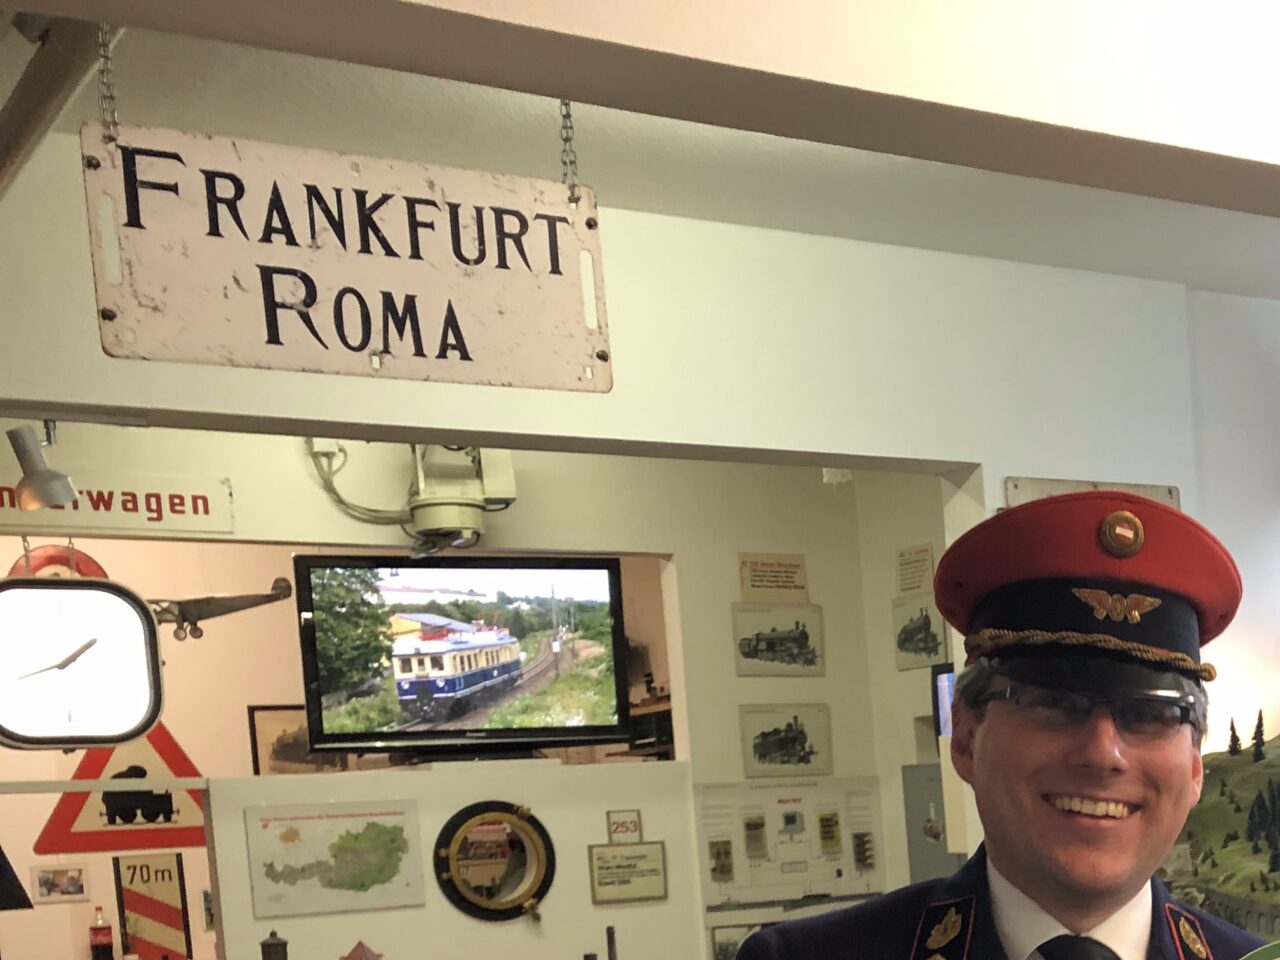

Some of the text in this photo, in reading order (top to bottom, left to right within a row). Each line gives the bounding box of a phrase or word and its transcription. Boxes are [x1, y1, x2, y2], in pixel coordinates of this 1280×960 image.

[118, 145, 571, 276] FRANKFURT
[256, 264, 473, 362] ROMA
[611, 820, 639, 834] 253
[126, 864, 173, 885] 70 m
